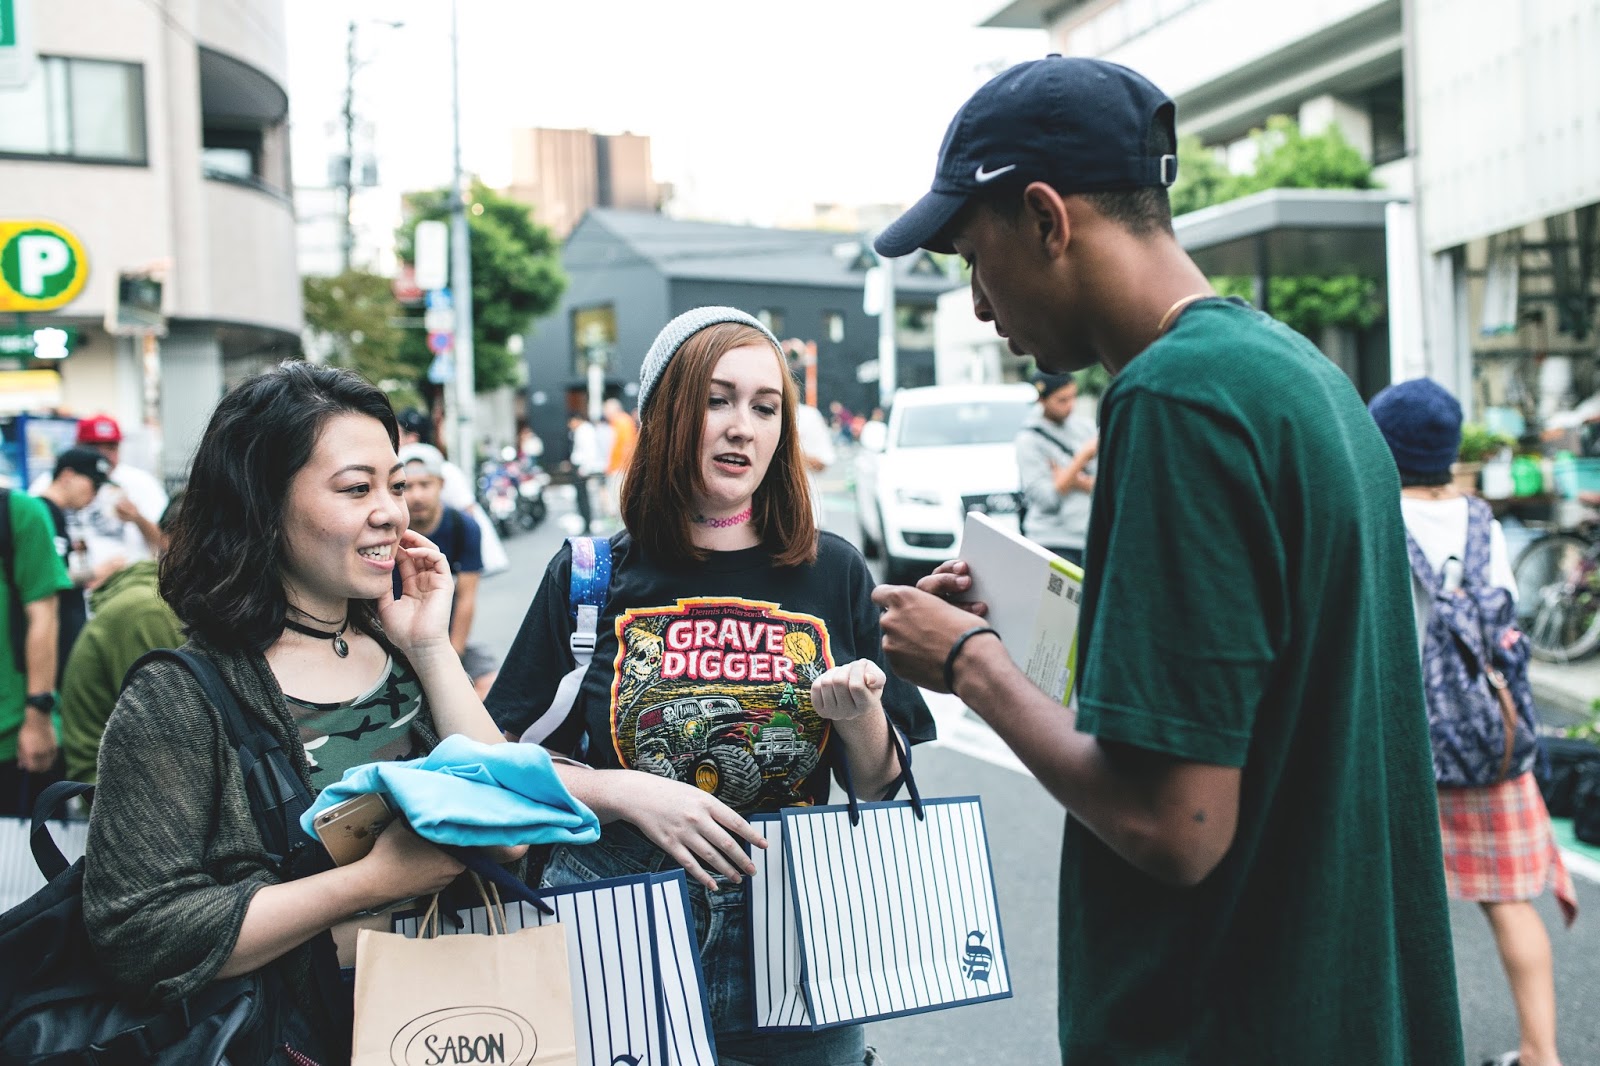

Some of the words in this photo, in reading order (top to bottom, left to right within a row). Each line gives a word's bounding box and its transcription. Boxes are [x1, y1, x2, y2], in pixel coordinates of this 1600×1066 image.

[17, 234, 71, 297] P
[690, 607, 721, 617] Dennis
[666, 619, 786, 651] GRAVE
[661, 650, 798, 683] DIGGER
[424, 1032, 505, 1066] SABON
